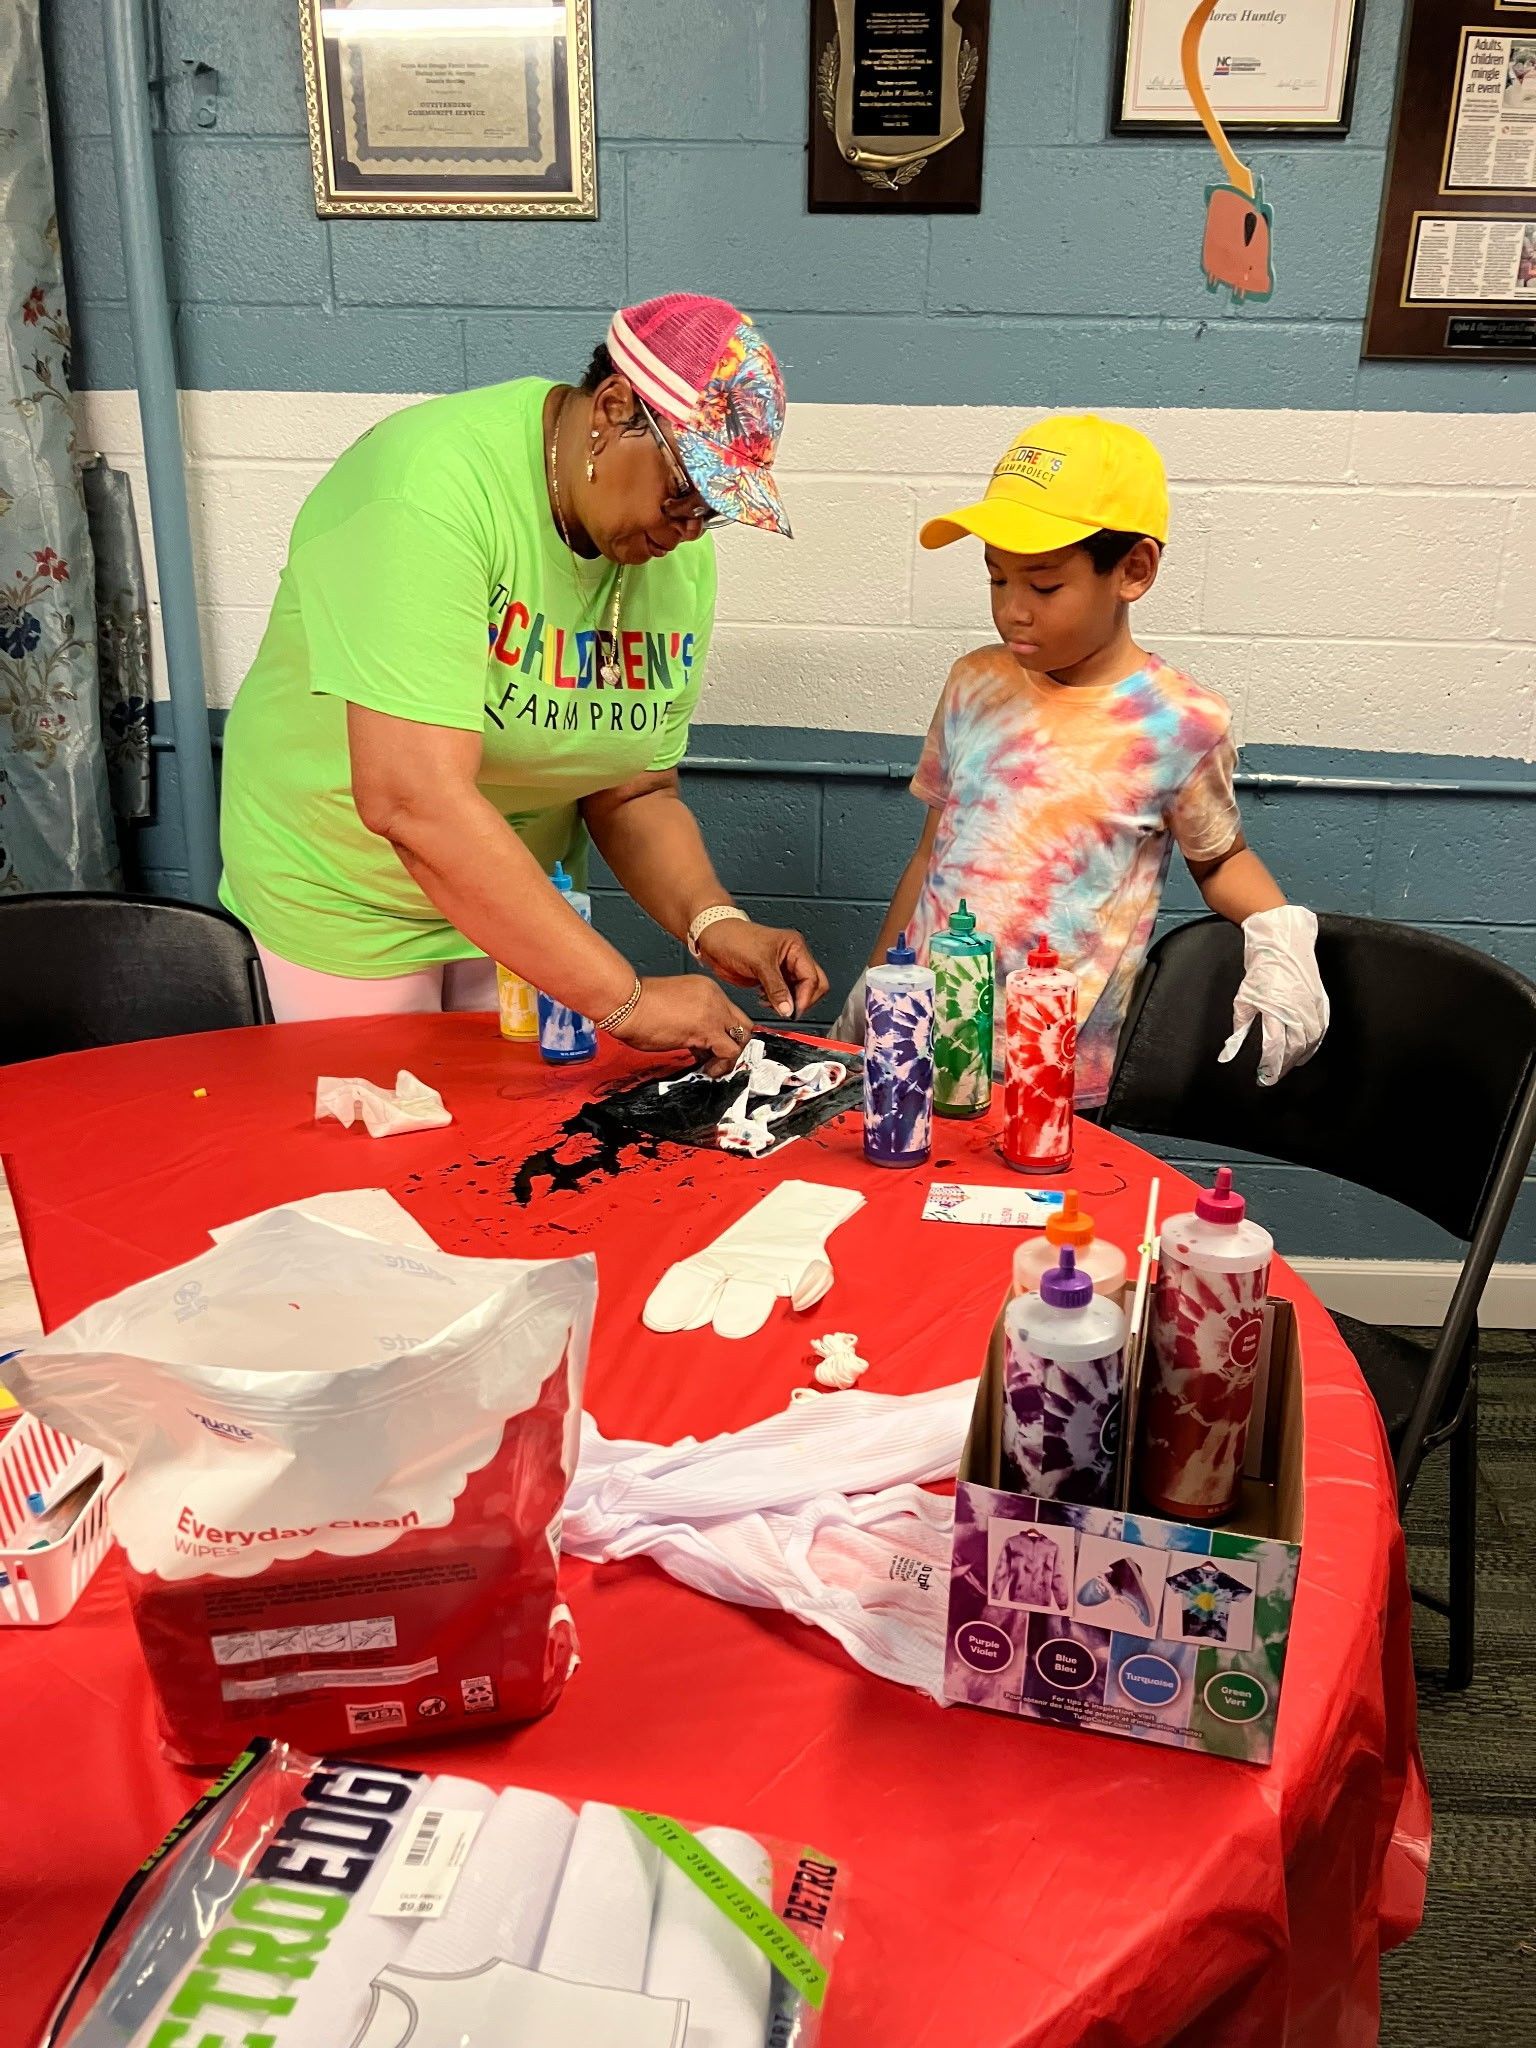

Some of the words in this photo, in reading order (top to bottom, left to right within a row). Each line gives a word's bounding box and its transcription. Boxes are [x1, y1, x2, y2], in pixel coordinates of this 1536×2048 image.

[1209, 9, 1237, 21] lores
[1240, 9, 1287, 24] Huntley
[1470, 53, 1504, 65] children
[1471, 68, 1500, 81] mingle
[1466, 83, 1476, 93] at
[1477, 83, 1501, 93] event
[499, 683, 579, 730] FARM
[177, 1506, 318, 1546] Everyday
[328, 1510, 420, 1528] Clean
[174, 1535, 241, 1558] WIPES
[968, 1634, 1000, 1649] Purple
[970, 1645, 998, 1658] Violet
[1055, 1653, 1078, 1665] Blue
[1054, 1663, 1077, 1674] Bleu
[1125, 1671, 1174, 1689] Turquoise
[1220, 1686, 1252, 1699] Green
[1224, 1696, 1247, 1708] Vert
[687, 1853, 729, 1889] FABRIC
[783, 1860, 837, 1930] RETRO
[726, 1893, 759, 1920] SOFT
[756, 1924, 819, 1984] EVERYDAY
